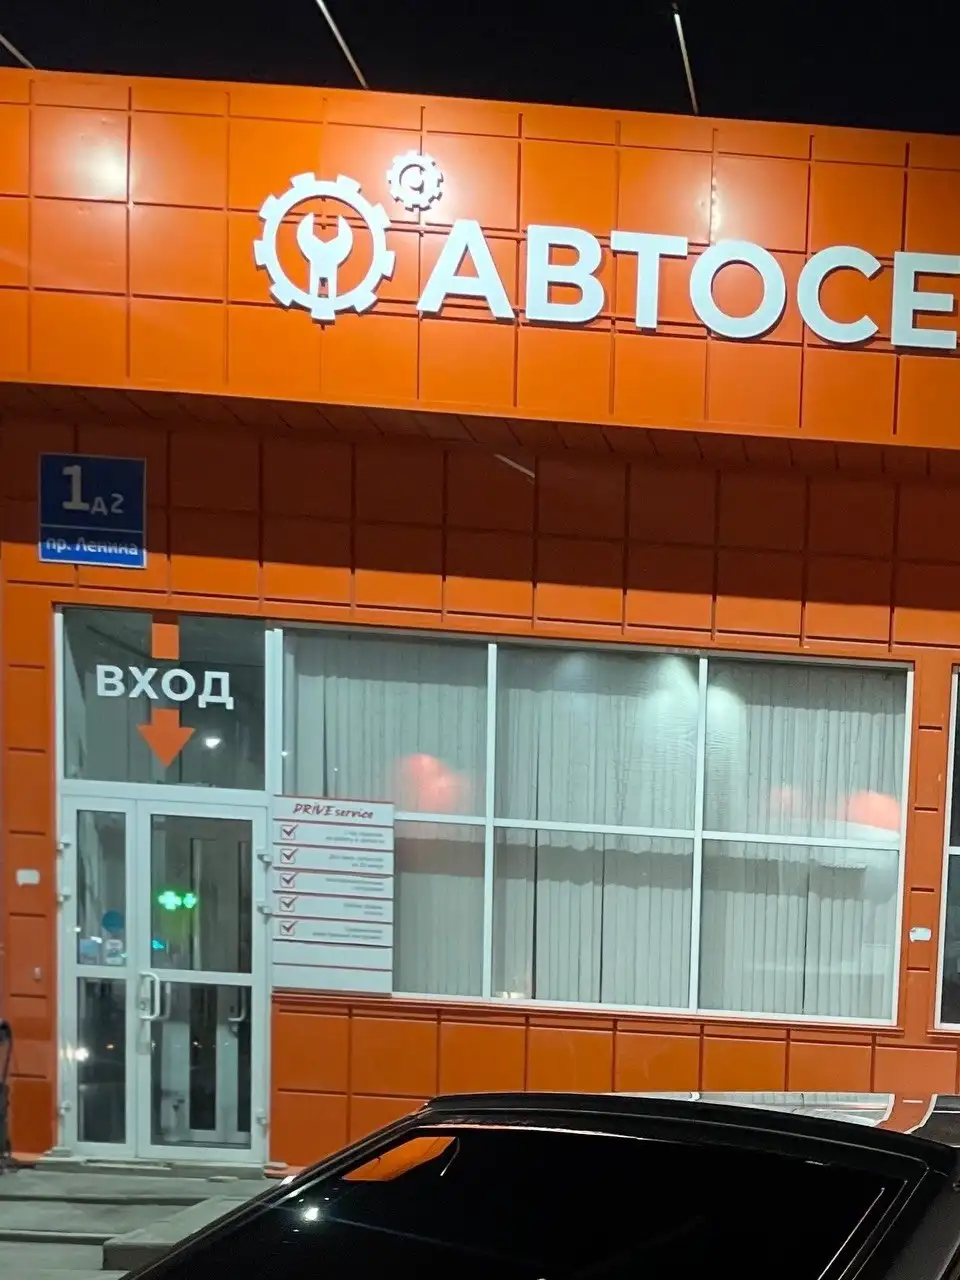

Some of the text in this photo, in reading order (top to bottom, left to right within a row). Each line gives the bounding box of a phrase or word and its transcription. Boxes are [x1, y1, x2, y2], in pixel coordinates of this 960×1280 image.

[45, 537, 139, 556] пр. Ленина
[96, 664, 234, 710] ВХОД
[335, 808, 373, 819] service
